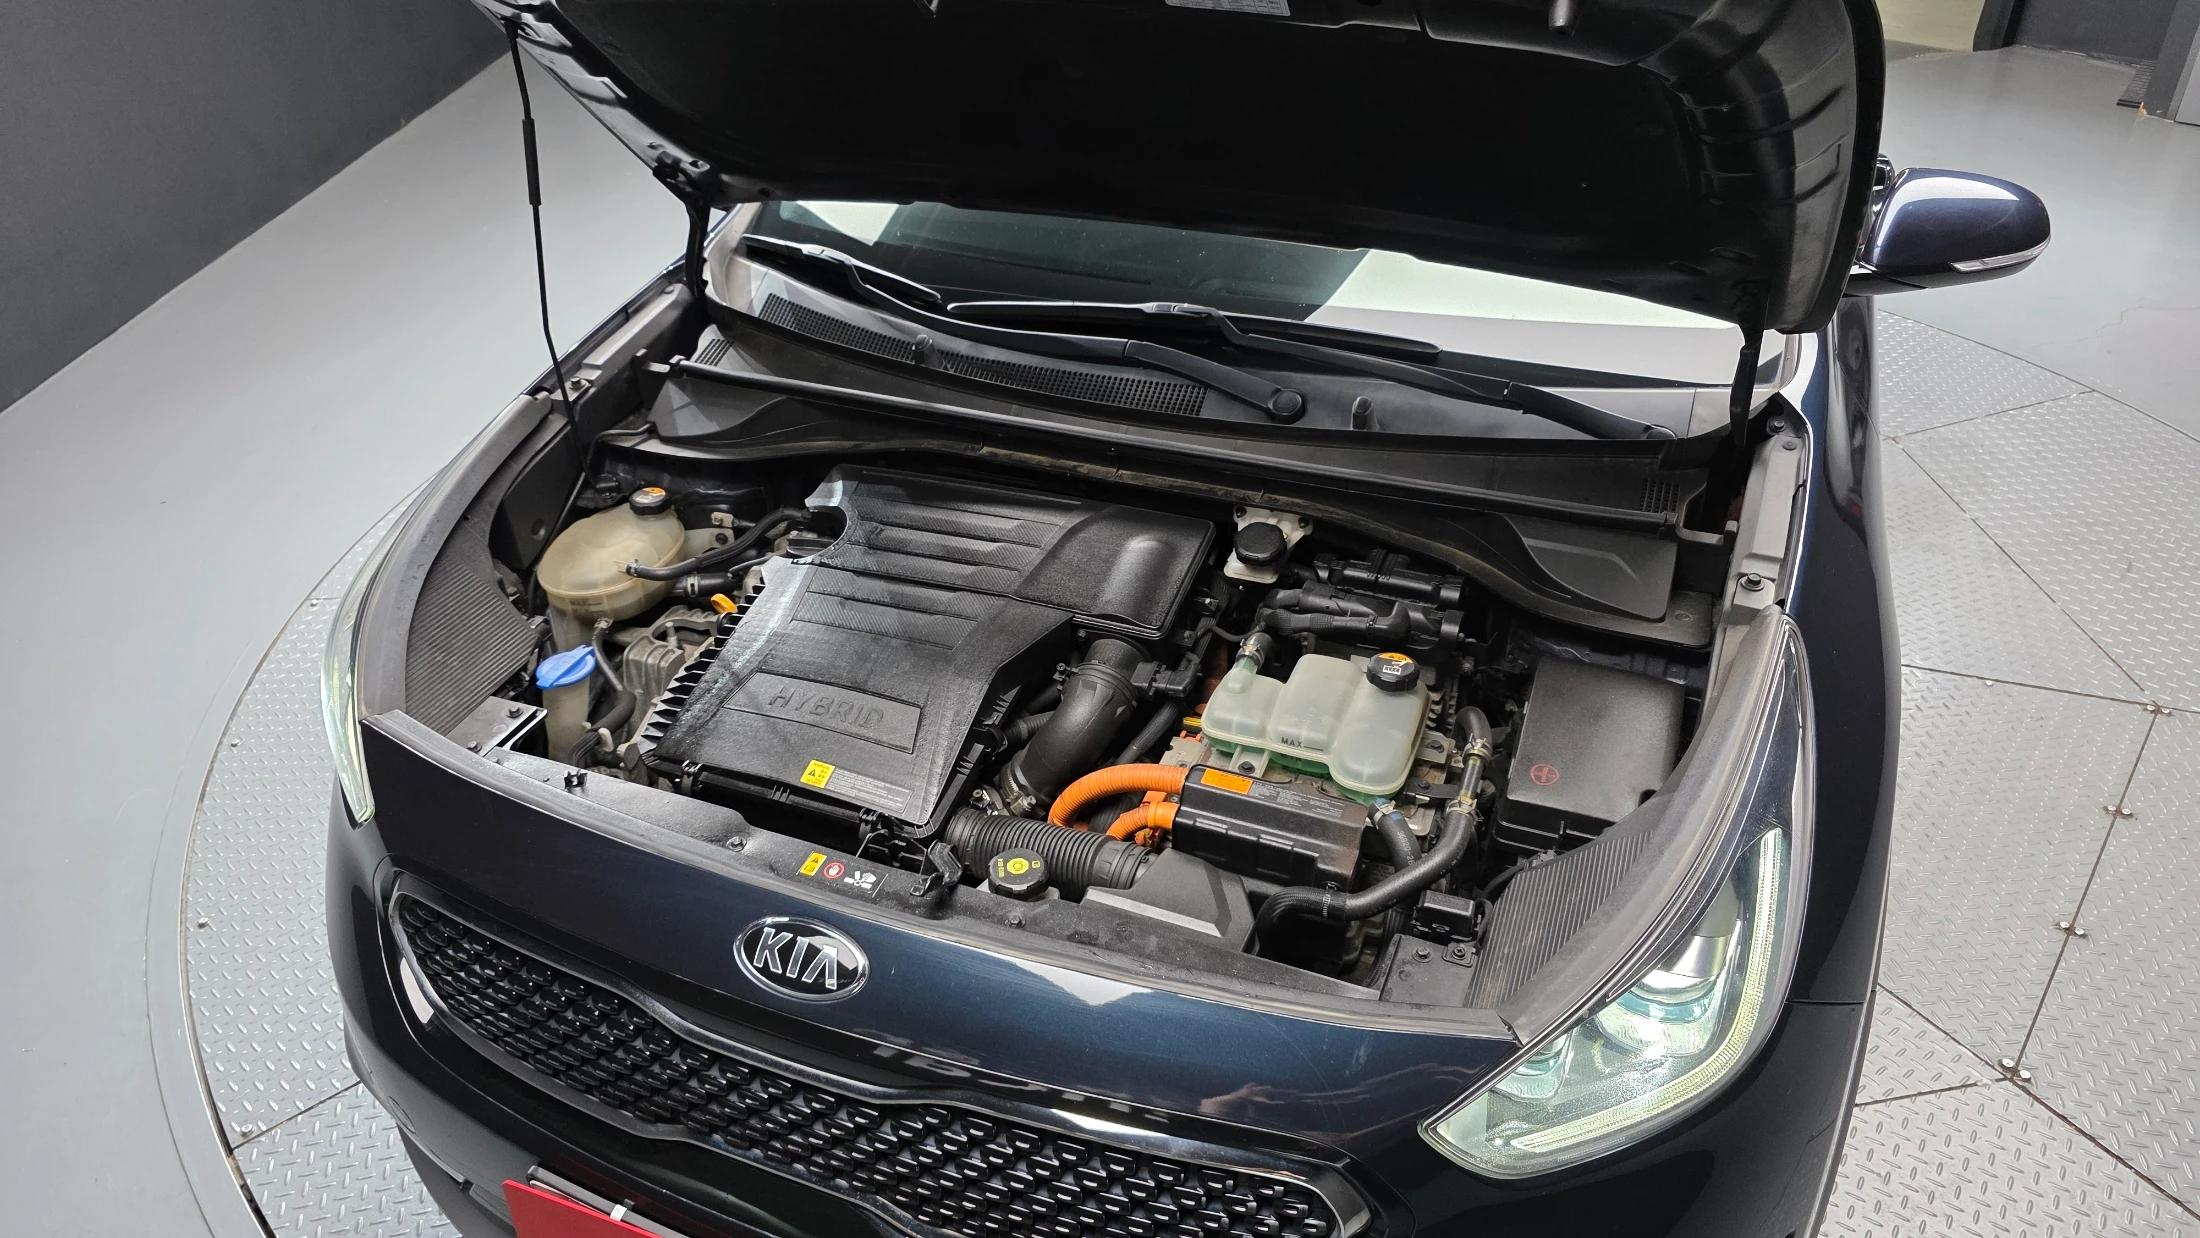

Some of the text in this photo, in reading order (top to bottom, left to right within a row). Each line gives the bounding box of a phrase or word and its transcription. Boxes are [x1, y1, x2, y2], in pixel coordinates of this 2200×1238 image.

[768, 685, 884, 728] HYBRID
[1281, 736, 1303, 748] MAX
[753, 926, 838, 990] KIA
